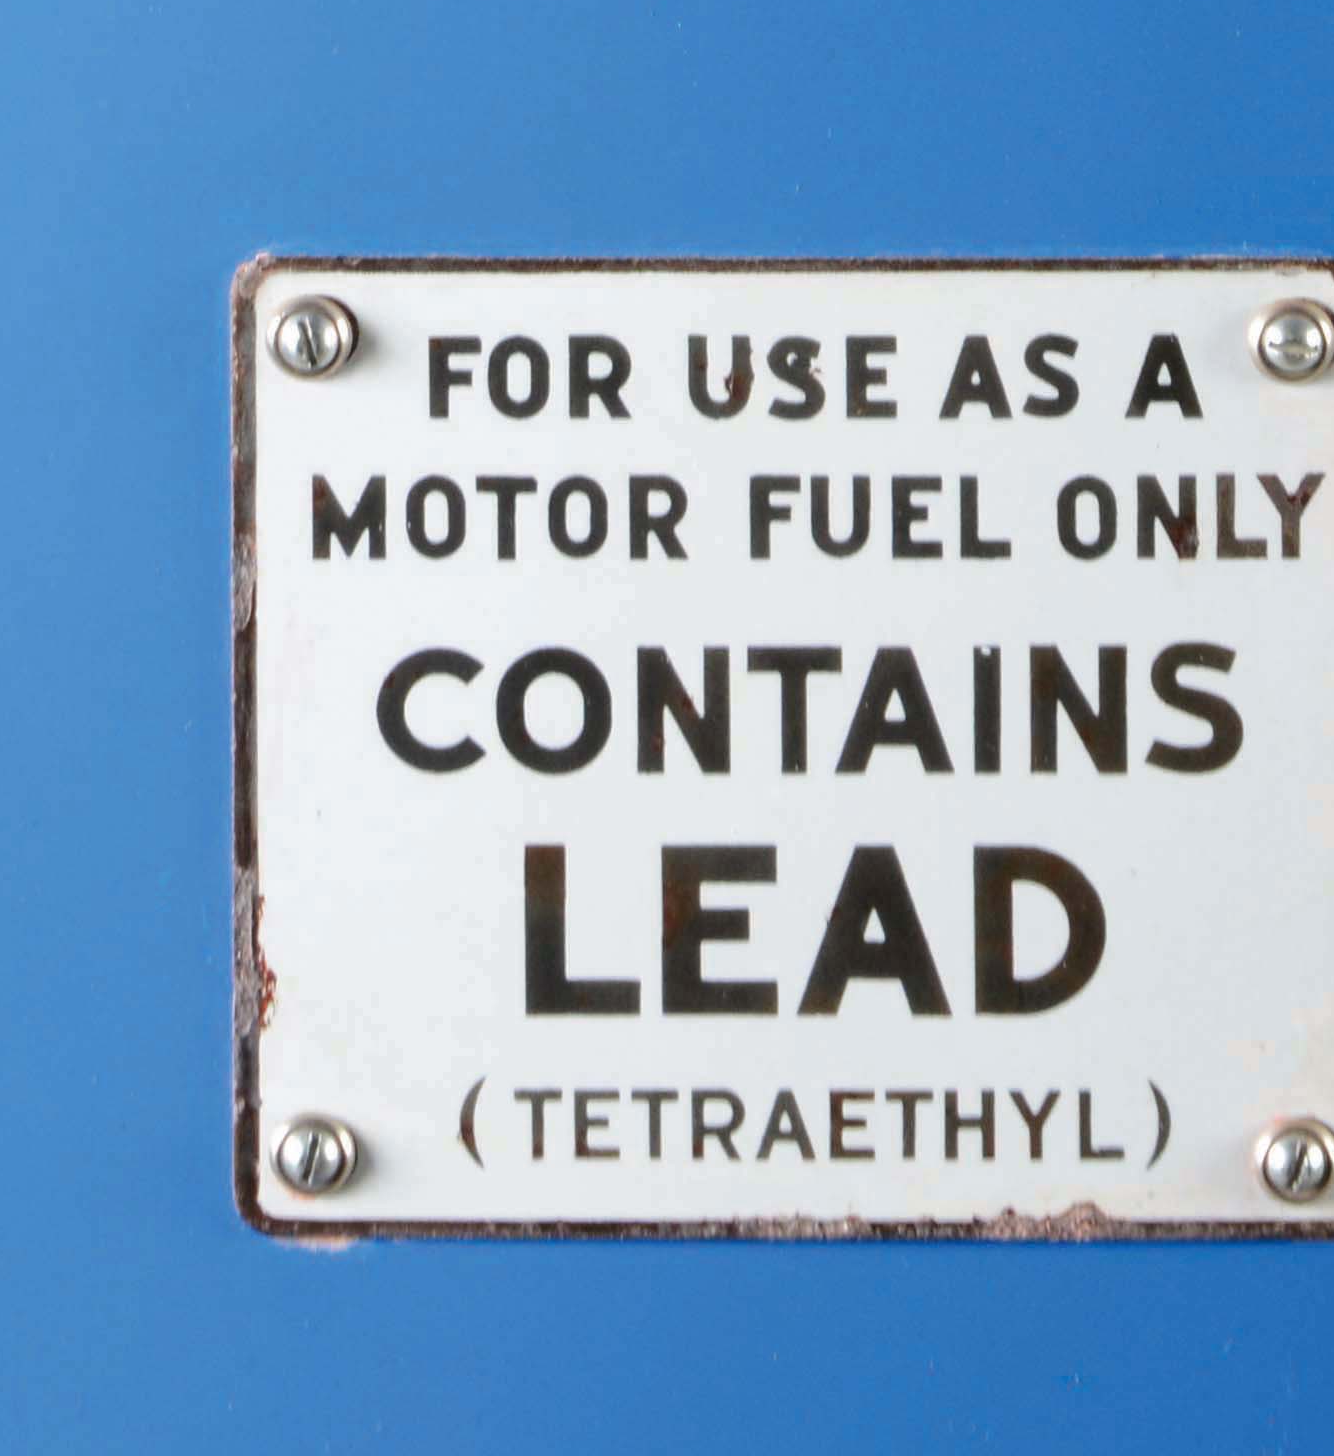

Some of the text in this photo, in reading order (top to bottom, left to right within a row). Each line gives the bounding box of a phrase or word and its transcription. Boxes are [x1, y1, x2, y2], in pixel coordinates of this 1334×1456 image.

[429, 334, 1203, 421] FOR USE AS A
[312, 473, 1324, 560] MOTOR FUEL ONLY
[376, 643, 1243, 775] CONTAINS
[525, 845, 1106, 1016] LEAD
[458, 1080, 1171, 1167] (TETRAETHYL)
